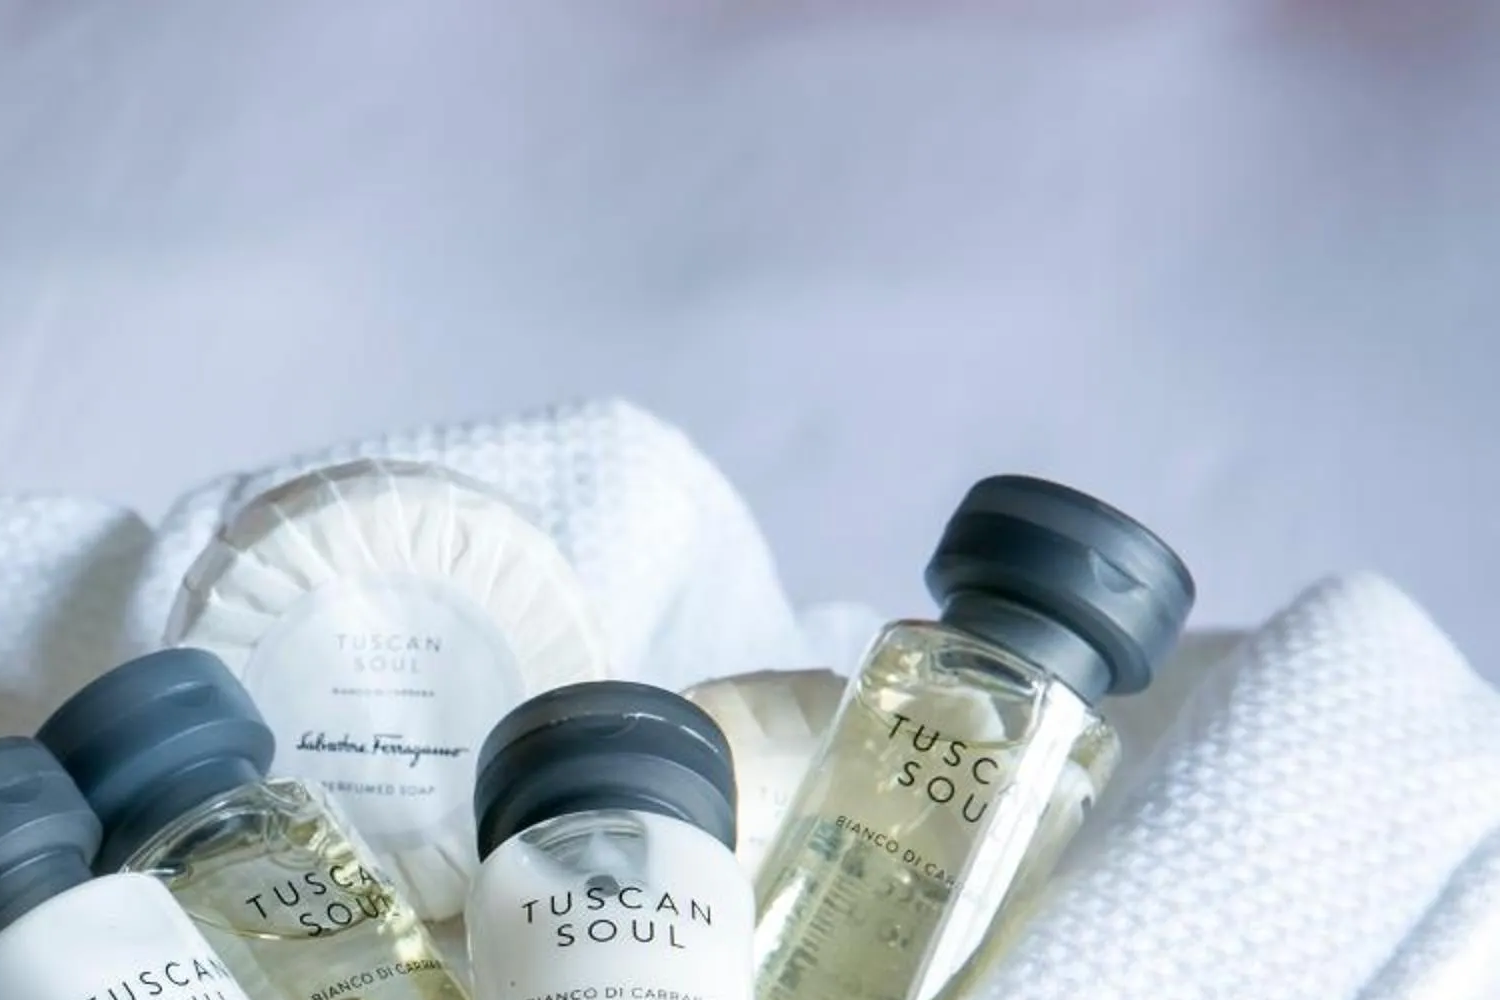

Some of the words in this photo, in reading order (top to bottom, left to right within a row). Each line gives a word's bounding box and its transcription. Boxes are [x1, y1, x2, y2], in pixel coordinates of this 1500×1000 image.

[336, 634, 442, 652] TUSCAN
[353, 656, 420, 674] SOUL
[887, 713, 999, 785] TUSC
[897, 761, 988, 823] SOU
[835, 815, 900, 854] BIANCO
[902, 849, 922, 867] DI
[245, 864, 380, 920] TUSCA
[522, 886, 711, 926] TUSCAN
[556, 918, 685, 948] SOUL
[378, 967, 394, 980] DI
[605, 987, 623, 999] DI
